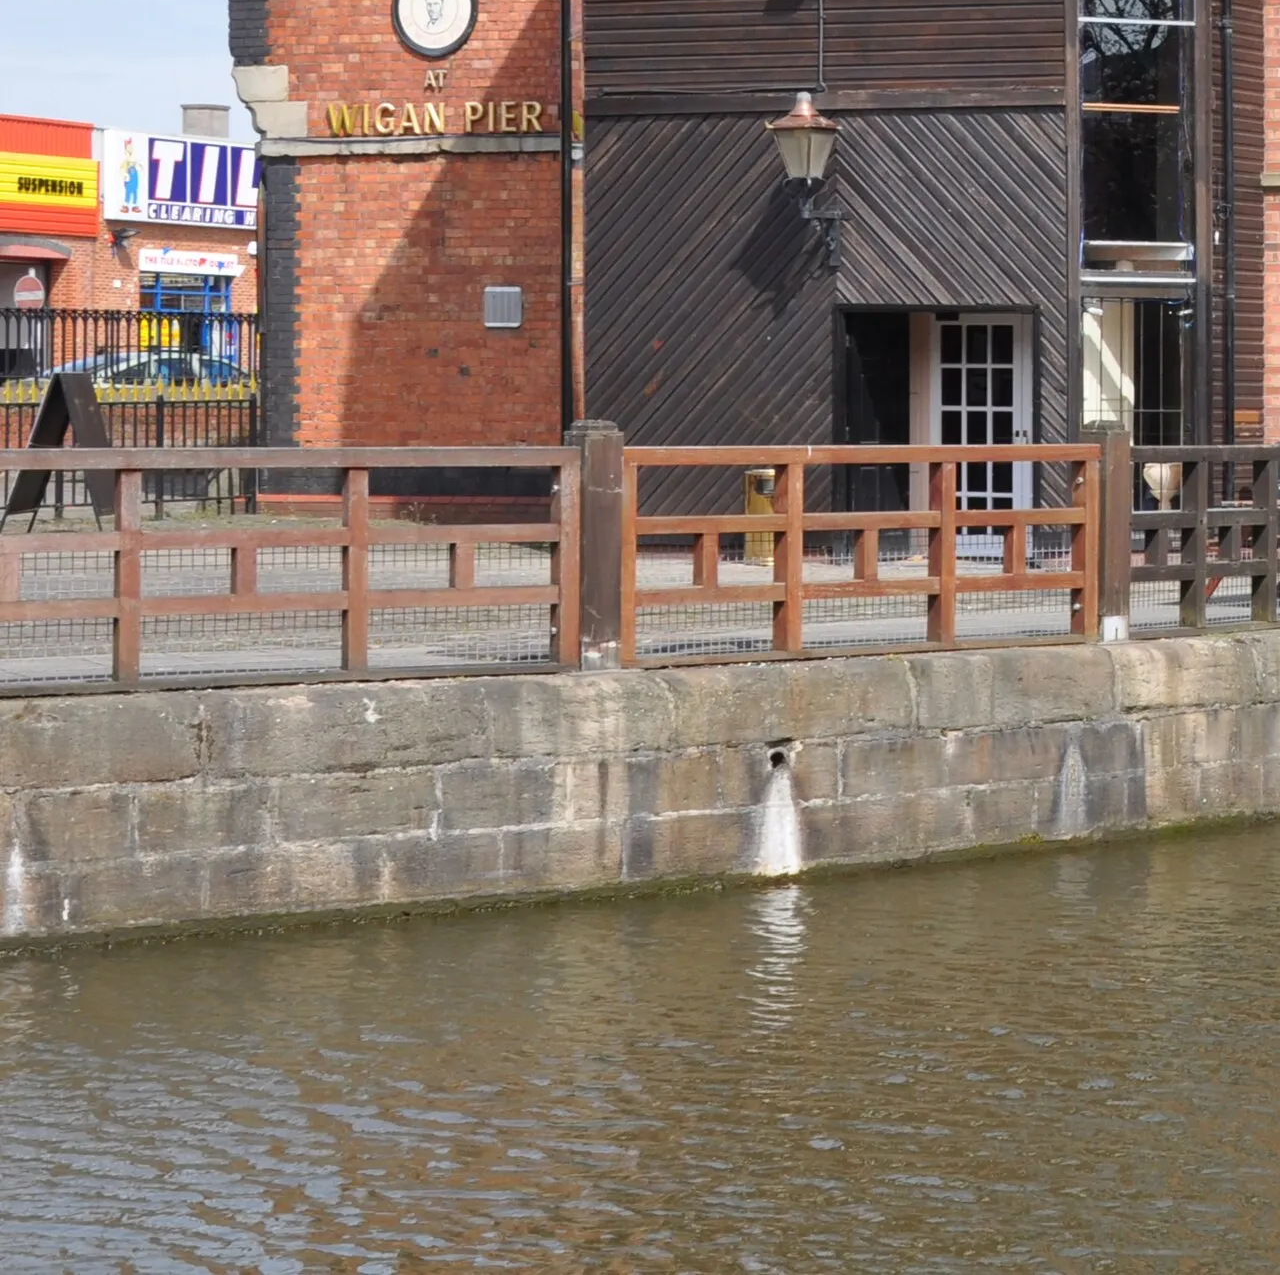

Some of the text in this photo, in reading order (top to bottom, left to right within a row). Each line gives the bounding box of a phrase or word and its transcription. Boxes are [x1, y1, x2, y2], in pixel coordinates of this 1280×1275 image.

[424, 68, 447, 90] AT
[327, 100, 543, 136] WIGAN PIER
[17, 176, 83, 197] SUSPENSION
[148, 204, 235, 225] CLEARING
